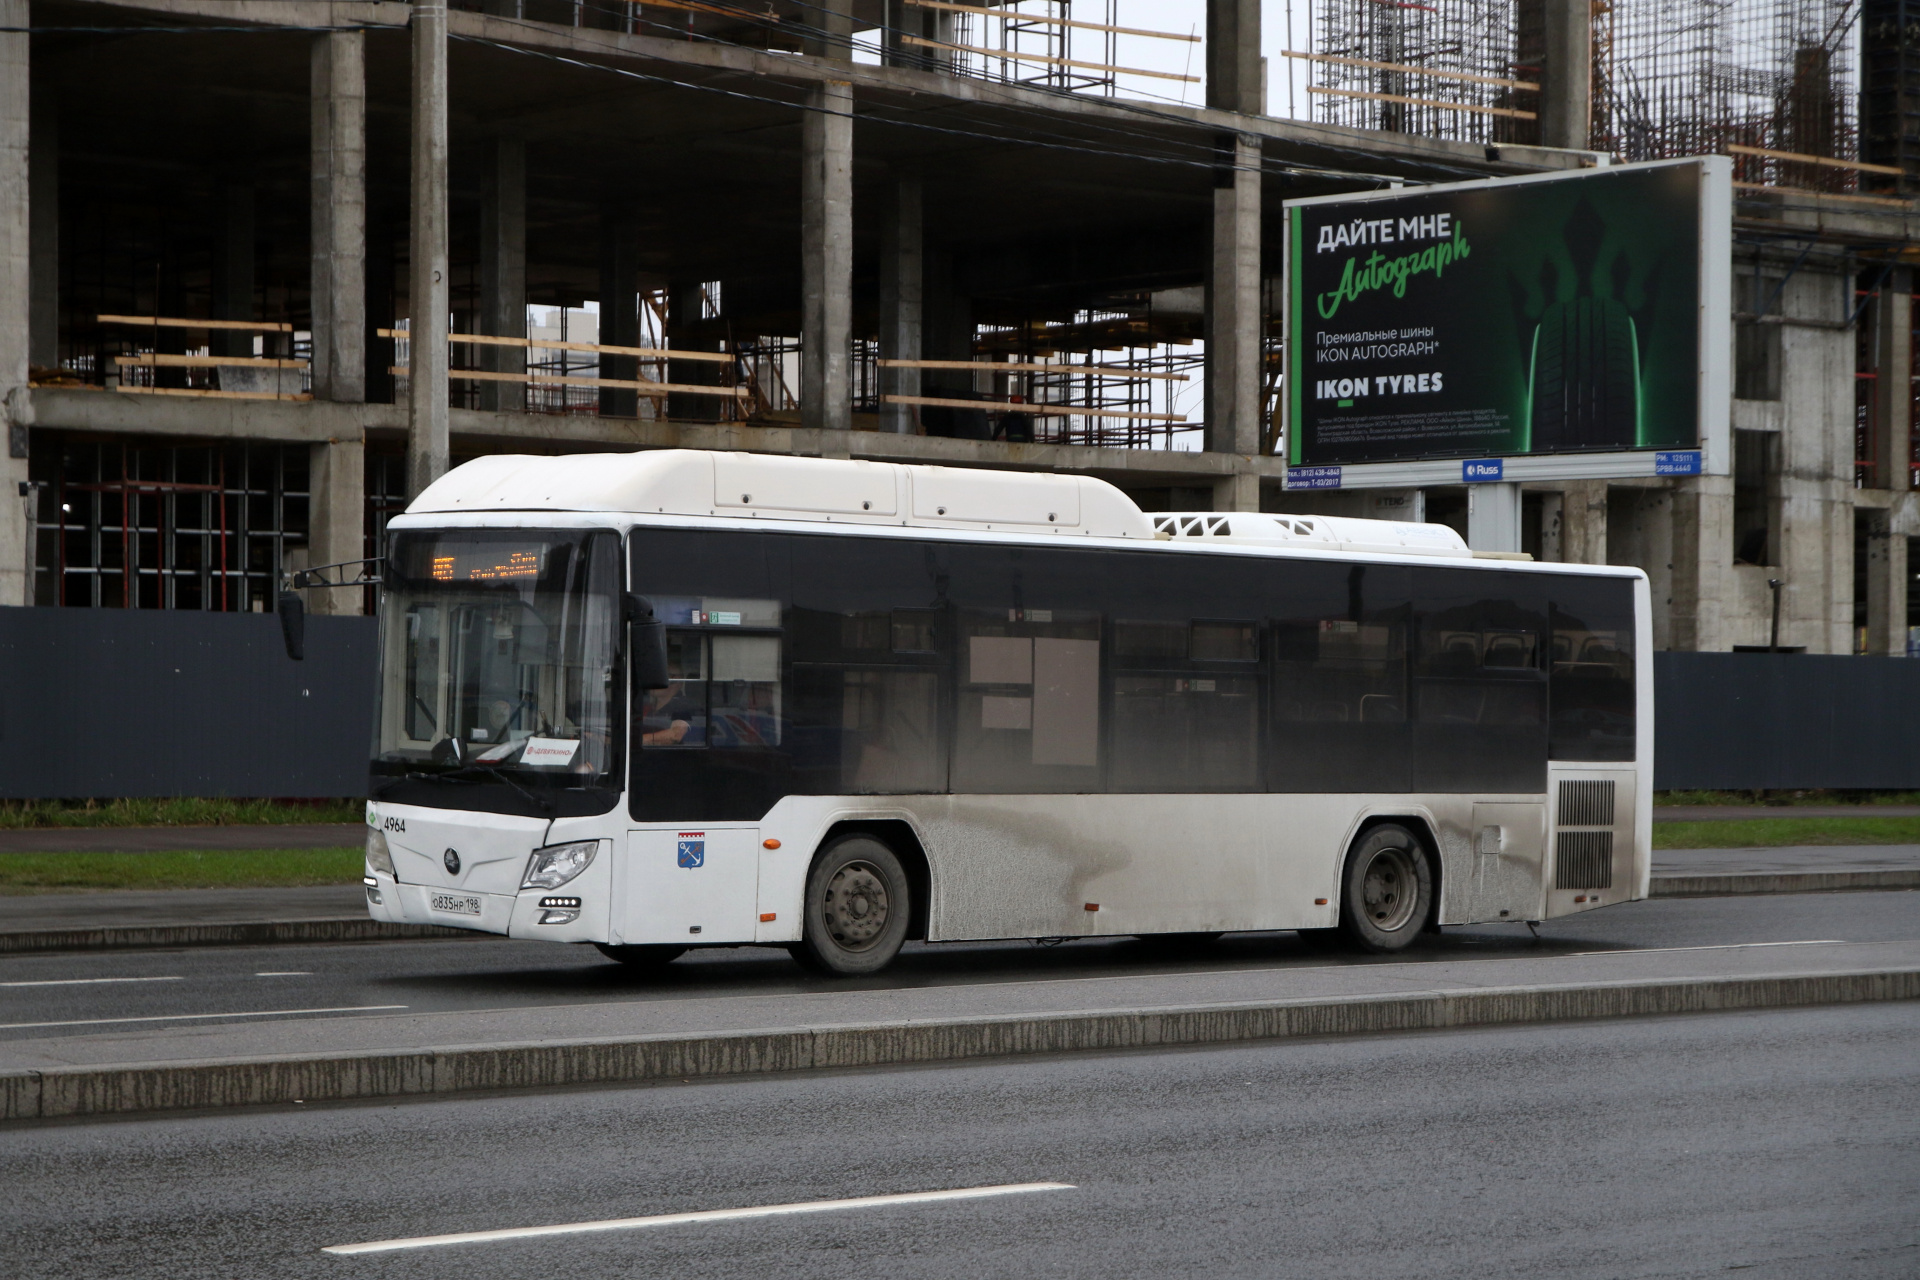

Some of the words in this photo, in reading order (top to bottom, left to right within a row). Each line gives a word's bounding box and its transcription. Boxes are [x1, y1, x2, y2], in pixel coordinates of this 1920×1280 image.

[1317, 219, 1394, 253] ДАЙТЕ
[1399, 213, 1451, 241] МНЕ
[1317, 220, 1470, 319] Autograph
[1317, 329, 1397, 347] Премиальные
[1400, 326, 1434, 338] шины
[1317, 348, 1348, 363] IKON
[1317, 377, 1369, 399] IKON
[1376, 372, 1443, 395] TYRES
[1477, 465, 1499, 475] Russ
[384, 817, 405, 833] 4964
